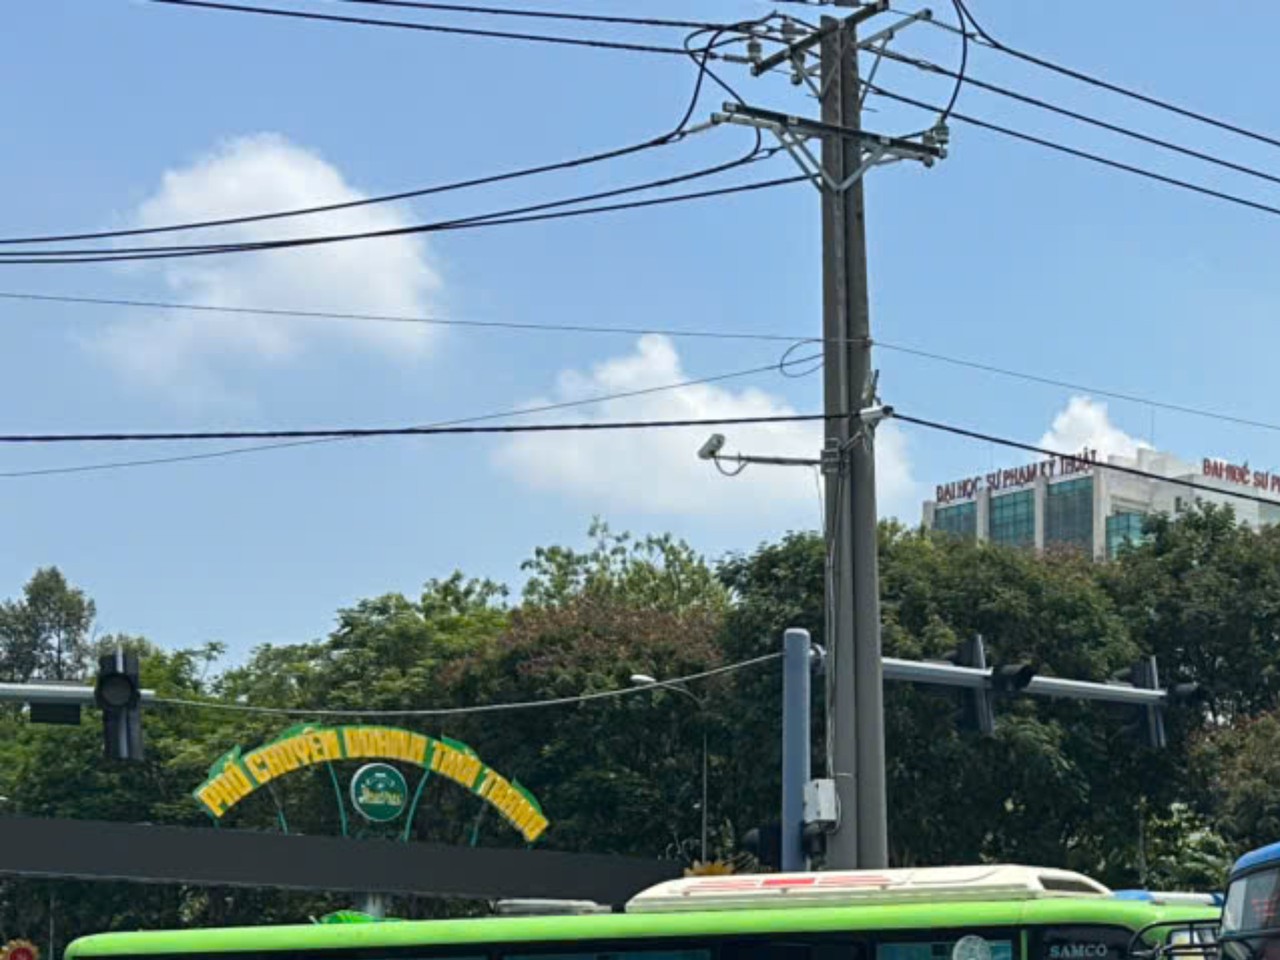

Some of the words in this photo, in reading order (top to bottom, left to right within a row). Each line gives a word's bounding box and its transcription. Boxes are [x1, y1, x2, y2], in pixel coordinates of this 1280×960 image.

[936, 479, 956, 503] ĐẠI
[957, 475, 982, 499] HỌC
[1003, 463, 1037, 488] PHẠM
[1050, 944, 1107, 958] SAMCO
